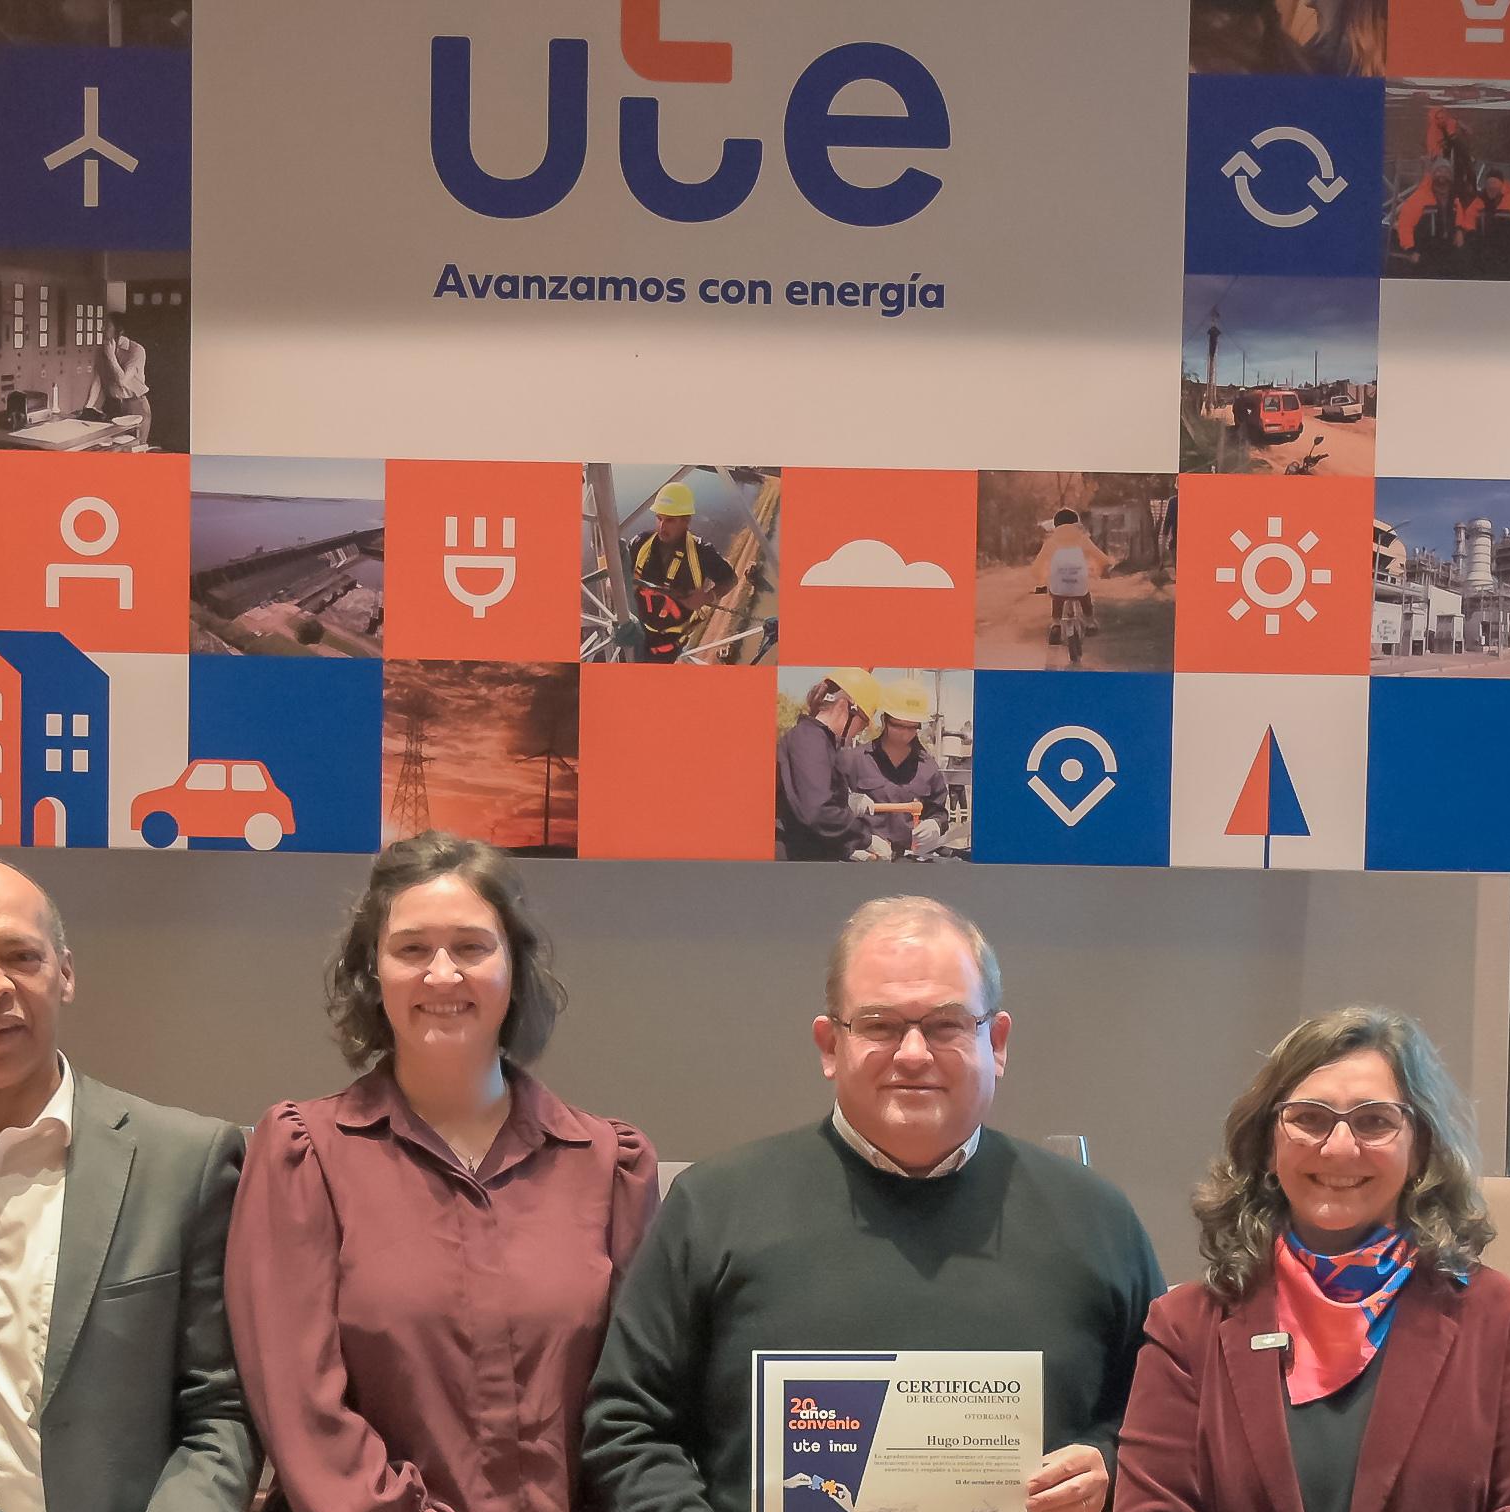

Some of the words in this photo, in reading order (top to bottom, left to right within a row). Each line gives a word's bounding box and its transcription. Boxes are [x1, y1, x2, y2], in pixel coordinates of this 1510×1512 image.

[430, 0, 951, 227] ute
[432, 263, 686, 303] Avanzamos
[697, 275, 772, 304] con
[785, 272, 945, 318] energía
[896, 1380, 1021, 1393] CERTIFICADO
[790, 1397, 816, 1414] 20
[906, 1395, 920, 1404] DE
[922, 1395, 1021, 1404] RECONOCIMIENTO
[799, 1406, 837, 1420] años
[788, 1415, 861, 1430] convenio
[792, 1438, 821, 1453] ute
[829, 1439, 858, 1453] inau
[927, 1435, 960, 1448] Hugo
[962, 1434, 1021, 1446] Dornelles
